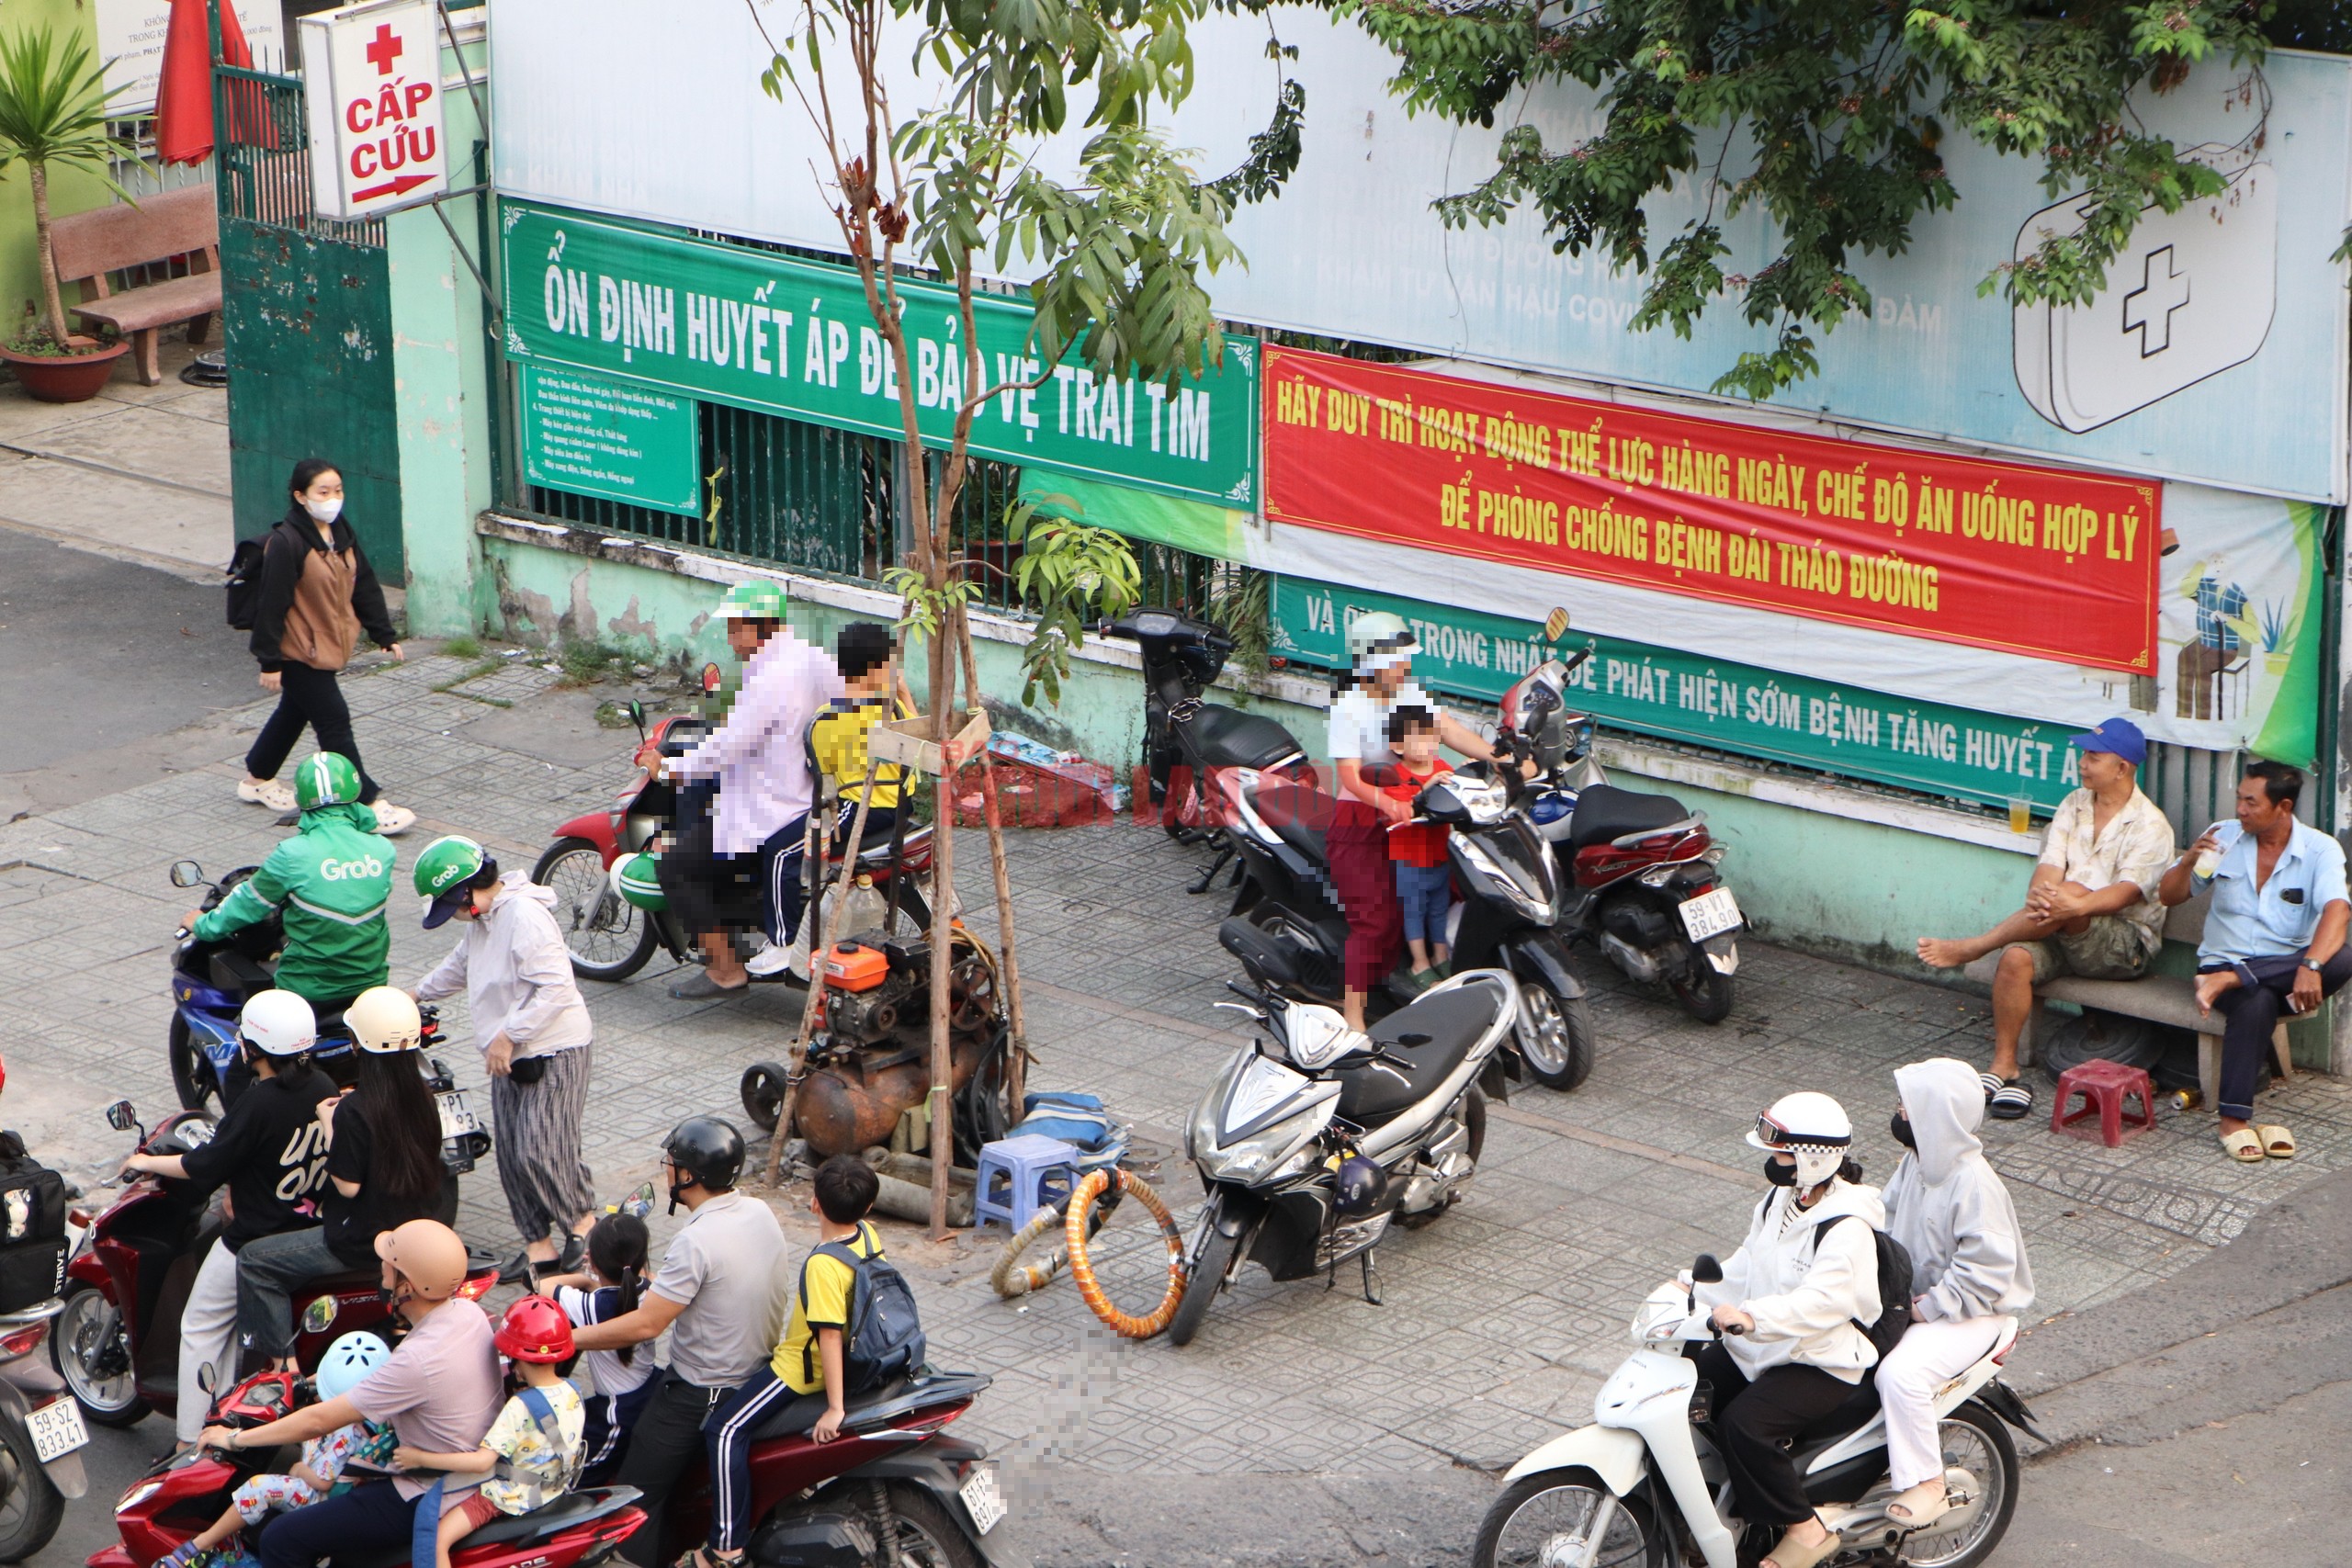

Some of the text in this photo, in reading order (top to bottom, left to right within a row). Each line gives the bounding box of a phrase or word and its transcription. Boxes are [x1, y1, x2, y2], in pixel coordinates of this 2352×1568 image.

[346, 75, 433, 133] CẤP
[350, 122, 435, 178] CỨU
[1505, 278, 1560, 320] HẬU
[1568, 292, 1641, 328] COVI
[544, 230, 589, 337] ỔN
[598, 275, 675, 362] ĐỊNH
[686, 280, 793, 378] HUYẾT
[805, 298, 849, 389] ÁP
[1146, 381, 1210, 462] TIM
[1277, 374, 2140, 563] HÃY DUY TRÌ HOẠT ĐỘNG THỂ LỰC HÀNG NGÀY, CHẾ ĐỘ ĂN UỐNG HỢP LÝ
[1441, 469, 1939, 612] ĐỂ PHÒNG CHỐNG BỆNH ĐÁI THÁO ĐƯỜNG
[1306, 589, 1335, 635] VÀ
[1409, 618, 1488, 670] TRỌNG
[1606, 656, 1670, 705] PHÁT
[1679, 668, 1737, 722] HIỆN
[1746, 680, 1800, 732] SỚM
[1809, 692, 1879, 747] BỆNH
[1887, 709, 1957, 763] TĂNG
[1965, 726, 2052, 780] HUYẾT
[2063, 739, 2079, 787] Á
[320, 854, 383, 881] Grab
[431, 864, 459, 887] Grab
[53, 1248, 65, 1295] STRIVE
[34, 1404, 74, 1434] 59-S2
[38, 1423, 84, 1458] 833.41
